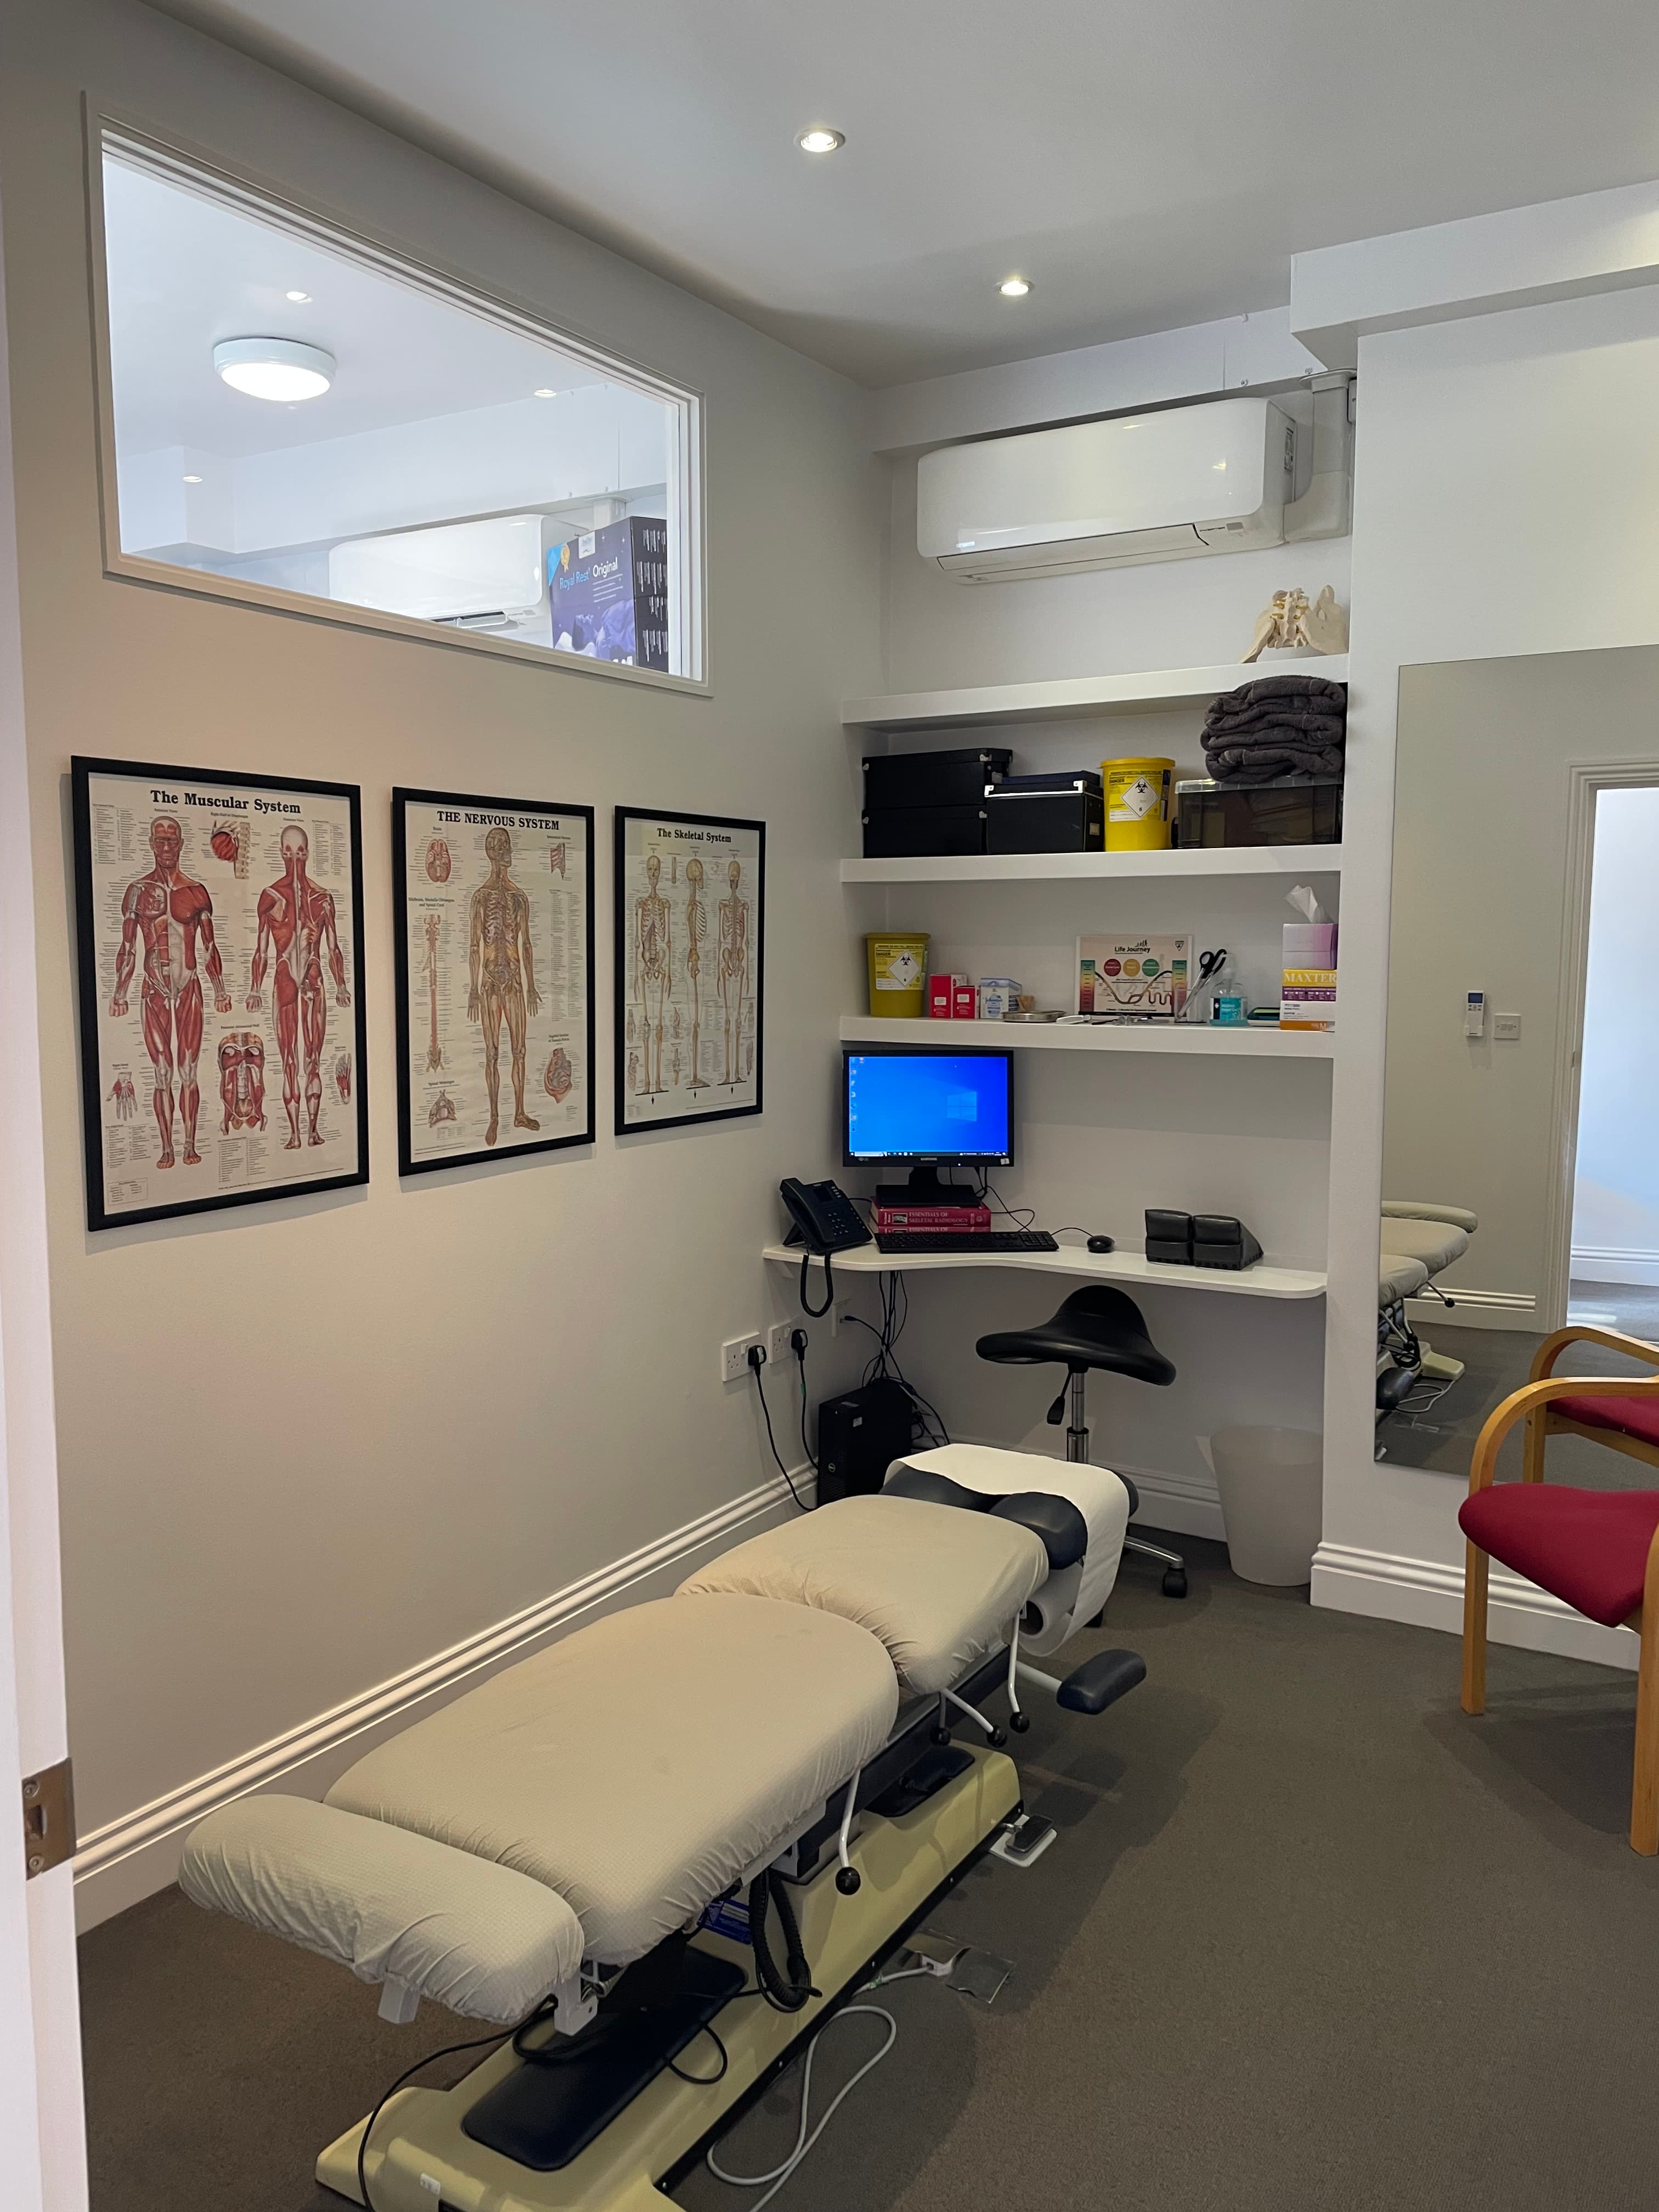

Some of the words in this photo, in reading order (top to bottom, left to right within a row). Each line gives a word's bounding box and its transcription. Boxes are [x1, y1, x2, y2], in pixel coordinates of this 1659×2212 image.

[560, 572, 575, 590] Royal
[576, 570, 589, 583] Rest
[592, 556, 618, 578] Original
[150, 790, 178, 804] The
[184, 793, 249, 809] Muscular
[254, 799, 301, 814] System
[437, 811, 460, 822] THE
[465, 813, 515, 827] NERVOUS
[518, 817, 559, 830] SYSTEM
[657, 828, 672, 838] The
[674, 829, 704, 840] Skeletal
[706, 832, 731, 843] System
[1284, 973, 1336, 983] MAXTER
